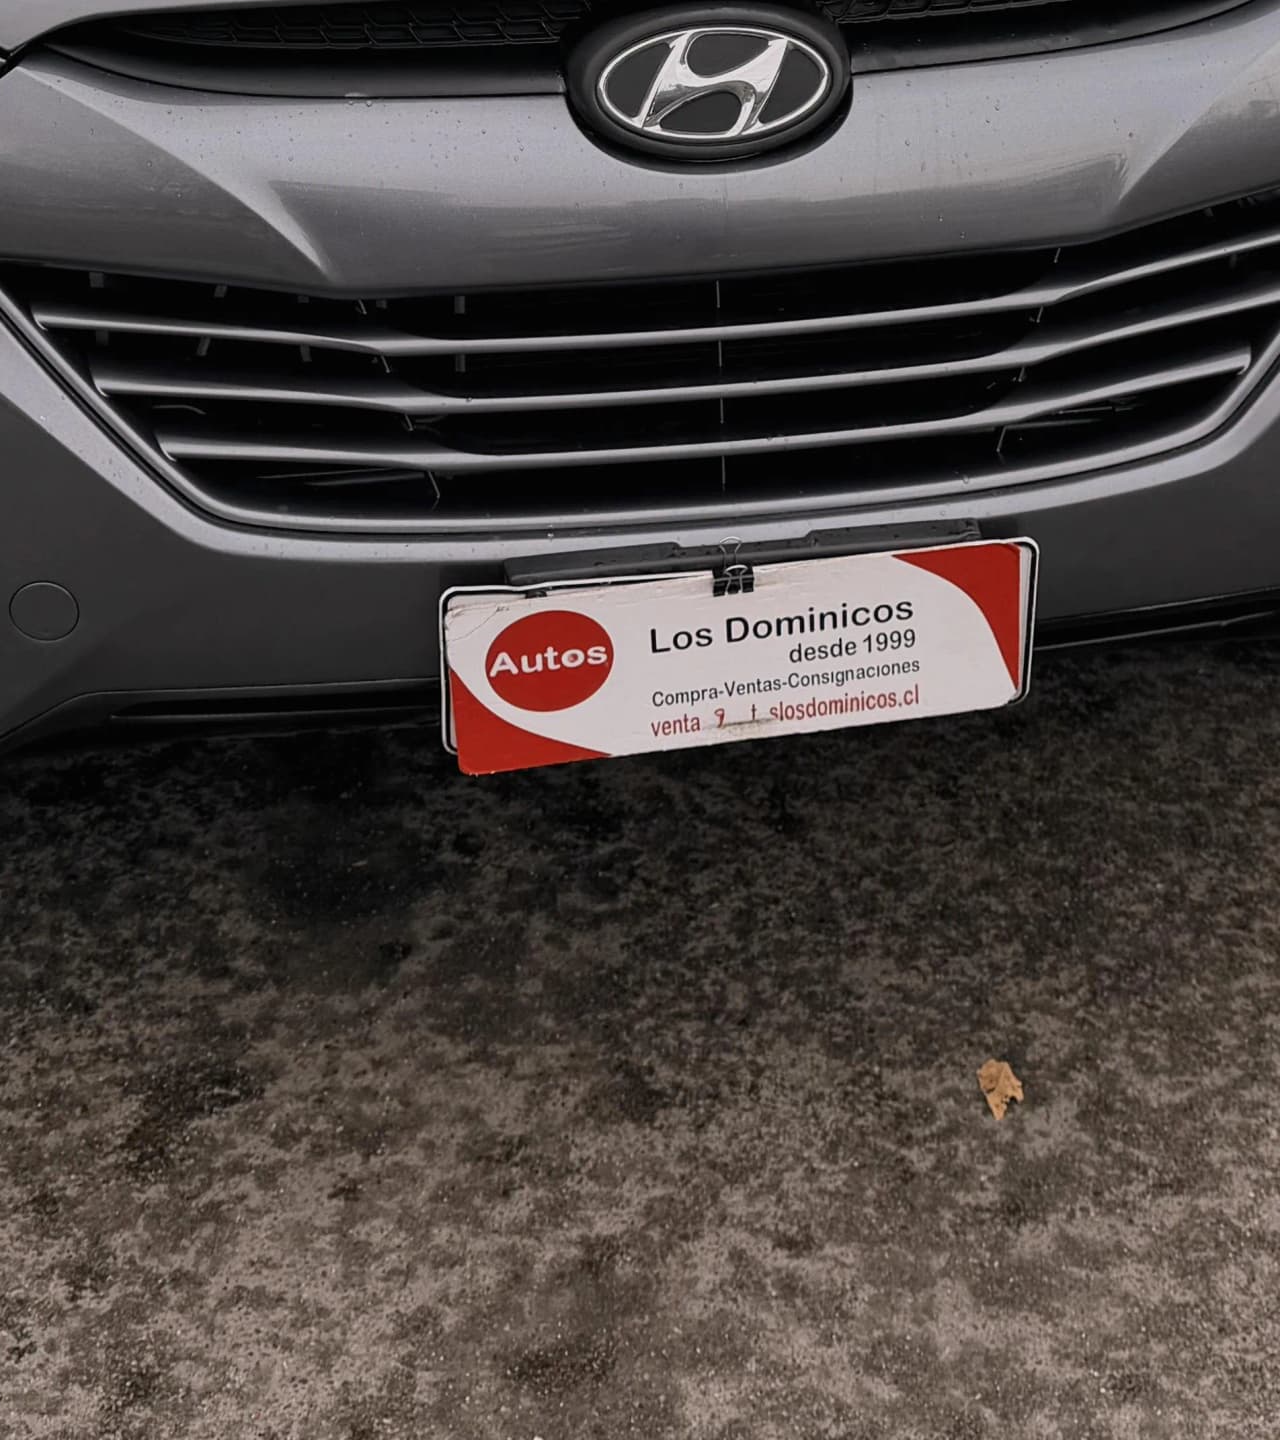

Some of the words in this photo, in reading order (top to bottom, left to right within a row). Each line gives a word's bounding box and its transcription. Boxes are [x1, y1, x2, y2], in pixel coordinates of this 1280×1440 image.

[649, 626, 714, 654] Los
[725, 600, 915, 644] Dominicos
[788, 637, 858, 664] desde
[862, 627, 917, 654] 1999
[488, 641, 609, 679] Autos
[651, 659, 921, 708] Compra-Ventas-Consignaciones
